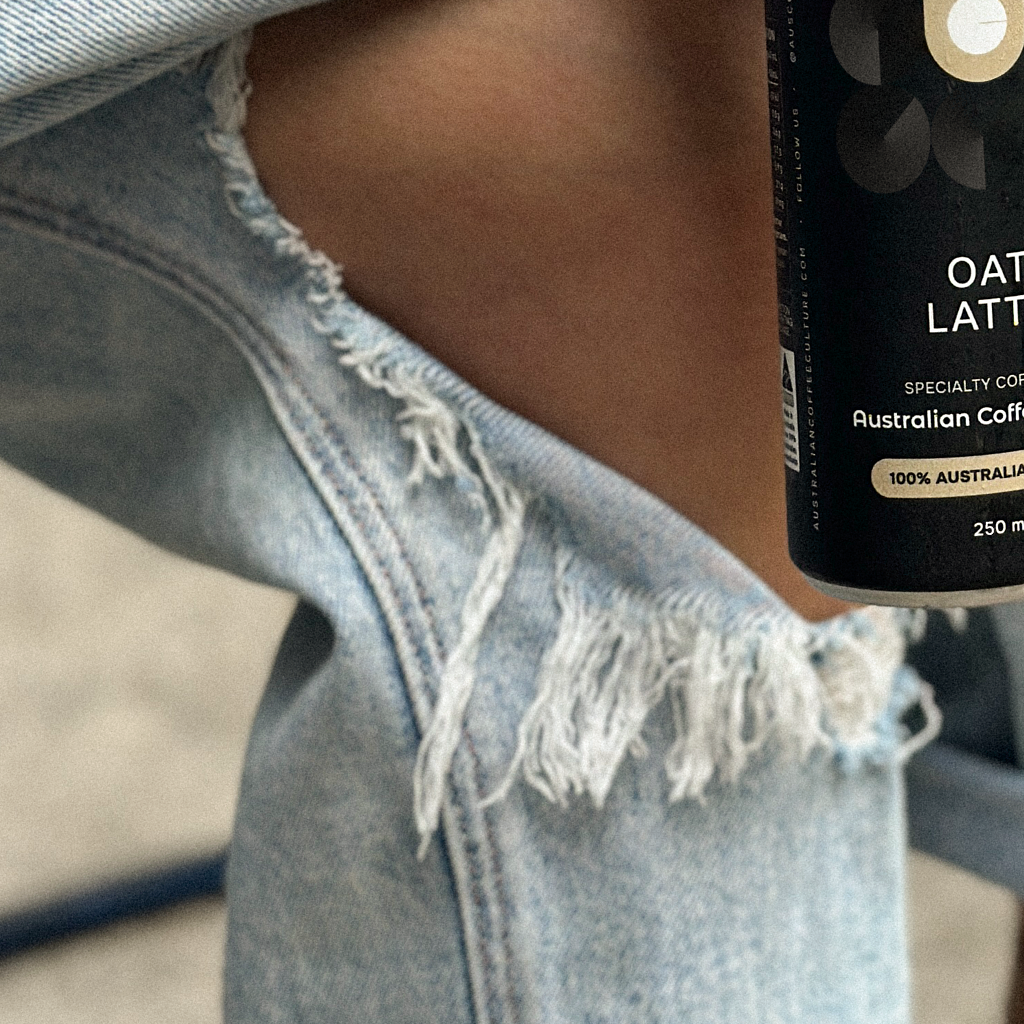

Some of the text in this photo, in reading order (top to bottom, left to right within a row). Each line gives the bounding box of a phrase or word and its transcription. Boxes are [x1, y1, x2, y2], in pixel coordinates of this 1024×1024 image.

[792, 107, 800, 128] US
[795, 137, 803, 203] FOLLOW
[904, 378, 991, 395] SPECIALTY
[853, 408, 971, 430] Australian
[889, 471, 931, 486] 100%
[973, 519, 1007, 537] 250
